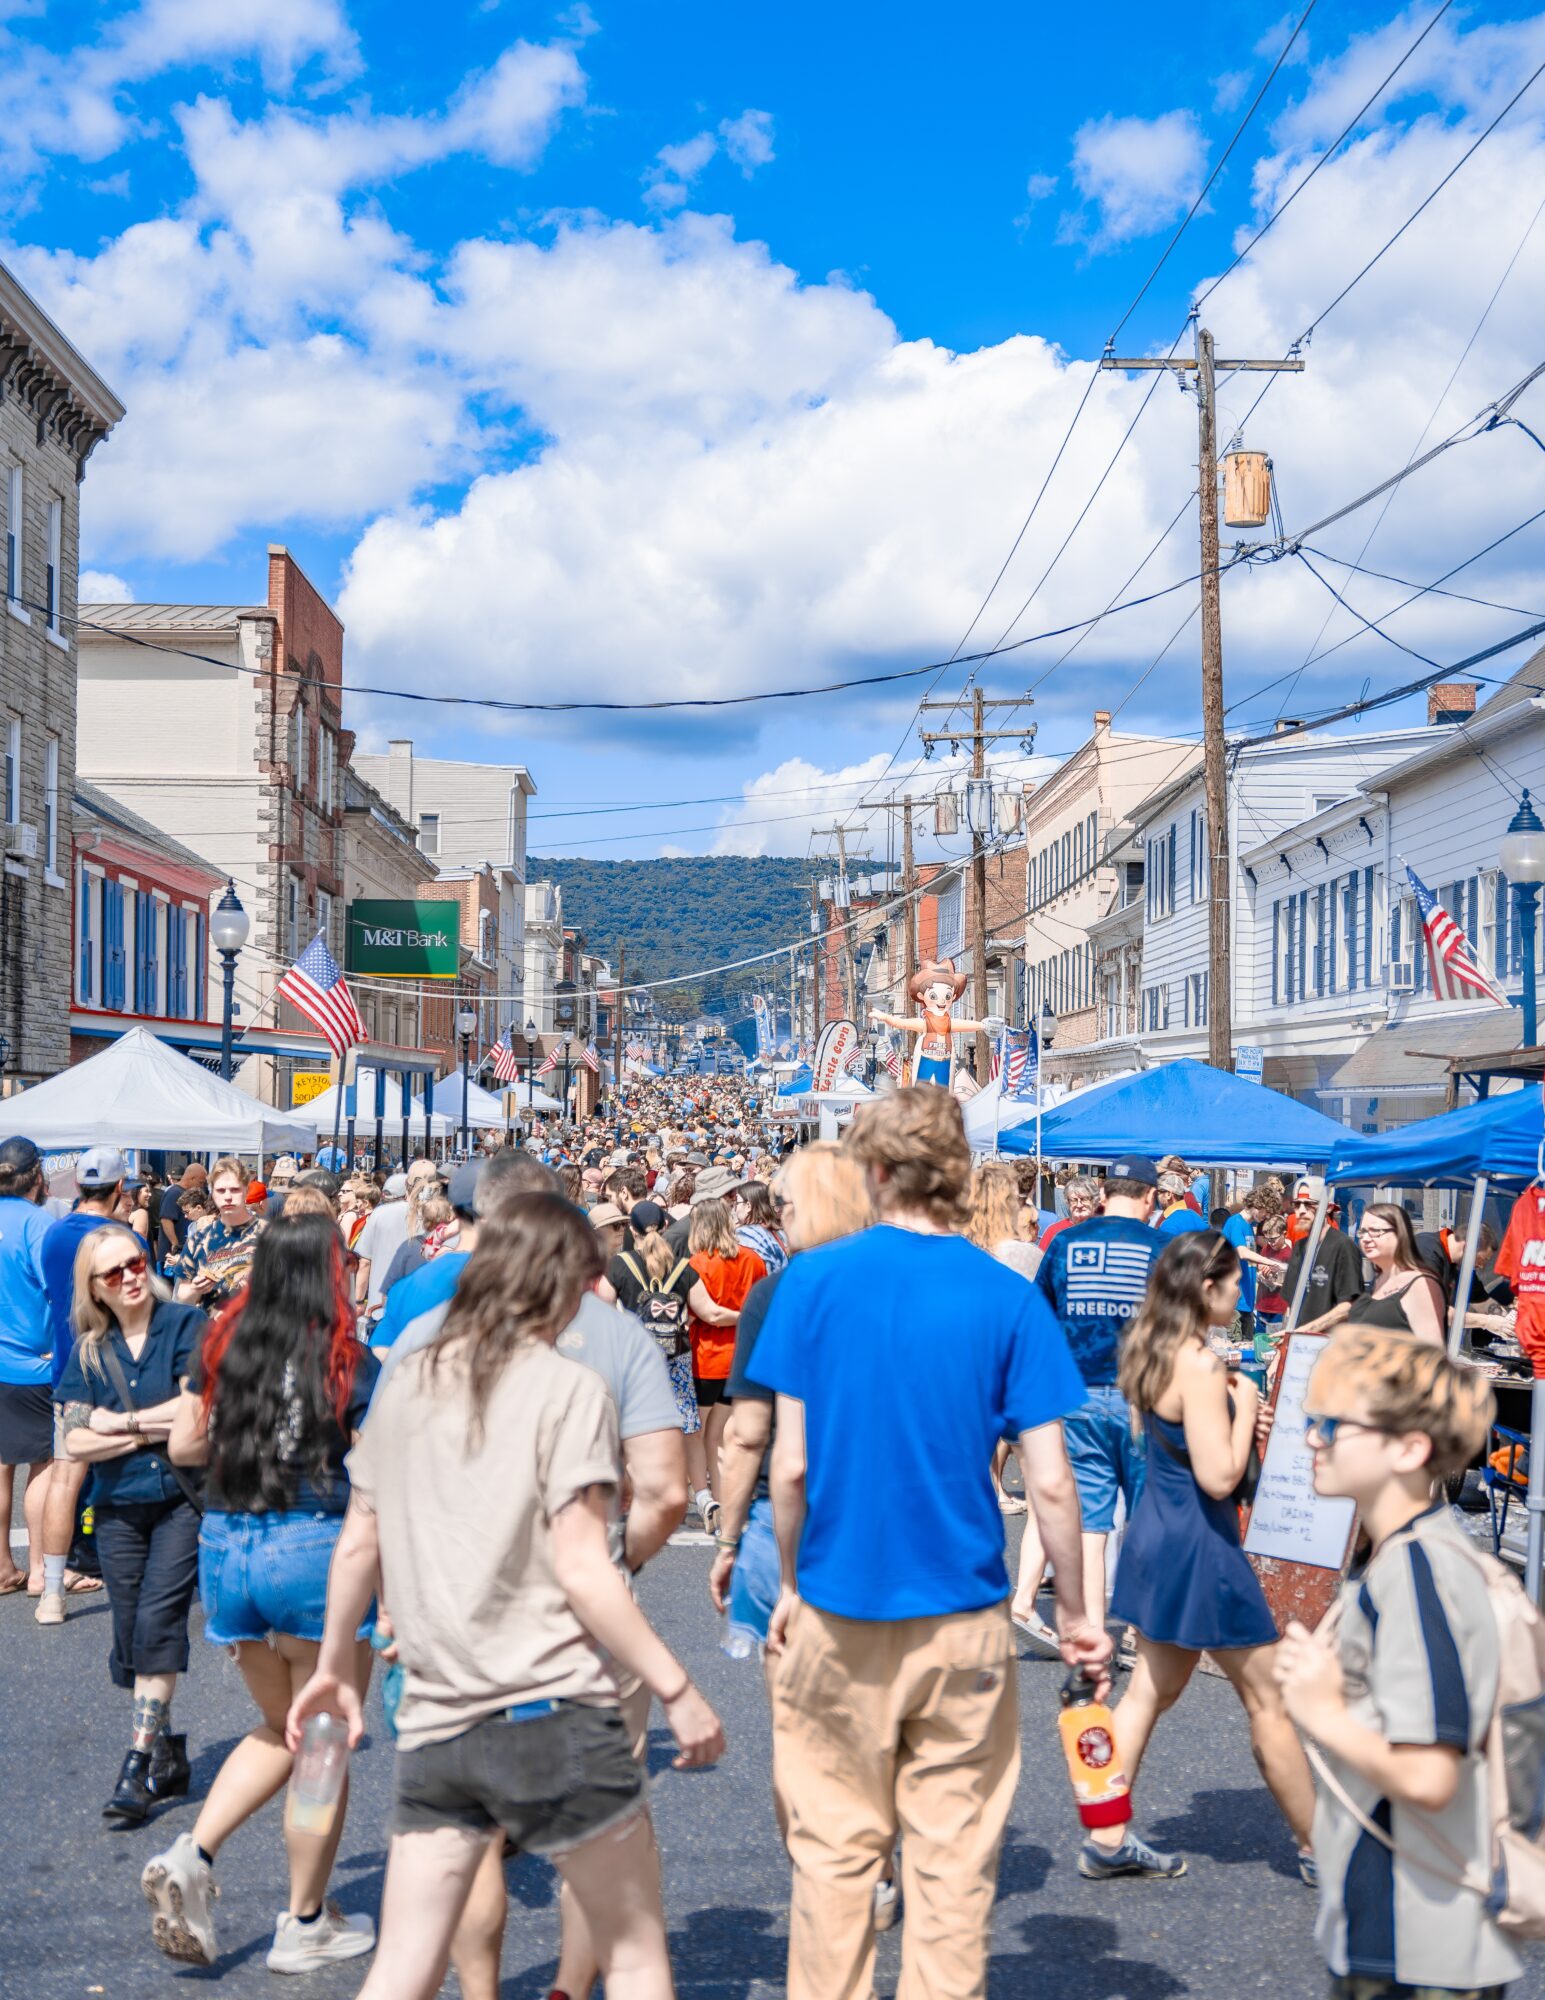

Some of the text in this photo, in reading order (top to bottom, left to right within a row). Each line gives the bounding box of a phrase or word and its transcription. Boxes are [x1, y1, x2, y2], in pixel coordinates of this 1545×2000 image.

[363, 929, 448, 947] M&T Bank
[833, 1026, 850, 1055] Corn
[850, 1064, 864, 1072] 25
[295, 1076, 332, 1088] KEYSTO
[294, 1094, 319, 1102] SOCIA
[46, 1151, 81, 1174] CON
